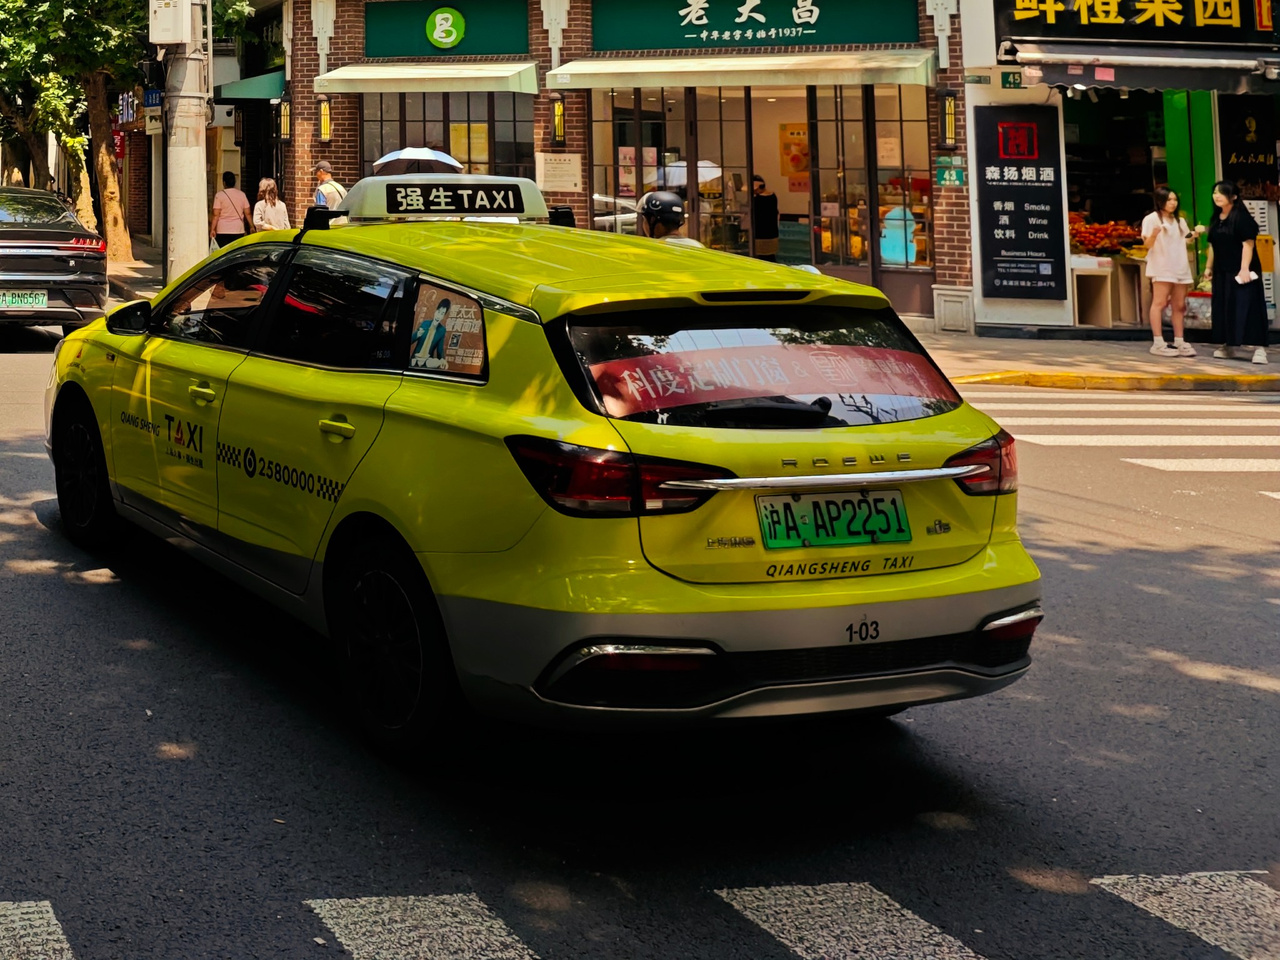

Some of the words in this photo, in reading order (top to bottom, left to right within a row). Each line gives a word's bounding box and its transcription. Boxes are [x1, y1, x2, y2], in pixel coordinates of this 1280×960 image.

[1008, 73, 1021, 84] 45
[943, 170, 956, 180] 43
[985, 166, 1054, 181] 森扬烟酒
[1024, 203, 1051, 211] Smoke
[1028, 217, 1048, 225] Wine
[994, 229, 1015, 239] 饮料
[1028, 231, 1049, 239] Drink
[1027, 250, 1046, 258] Hours
[165, 413, 203, 453] TAXI
[766, 559, 871, 578] QIANGSHENG
[883, 555, 915, 570] TAXI
[845, 620, 880, 642] 1-03
